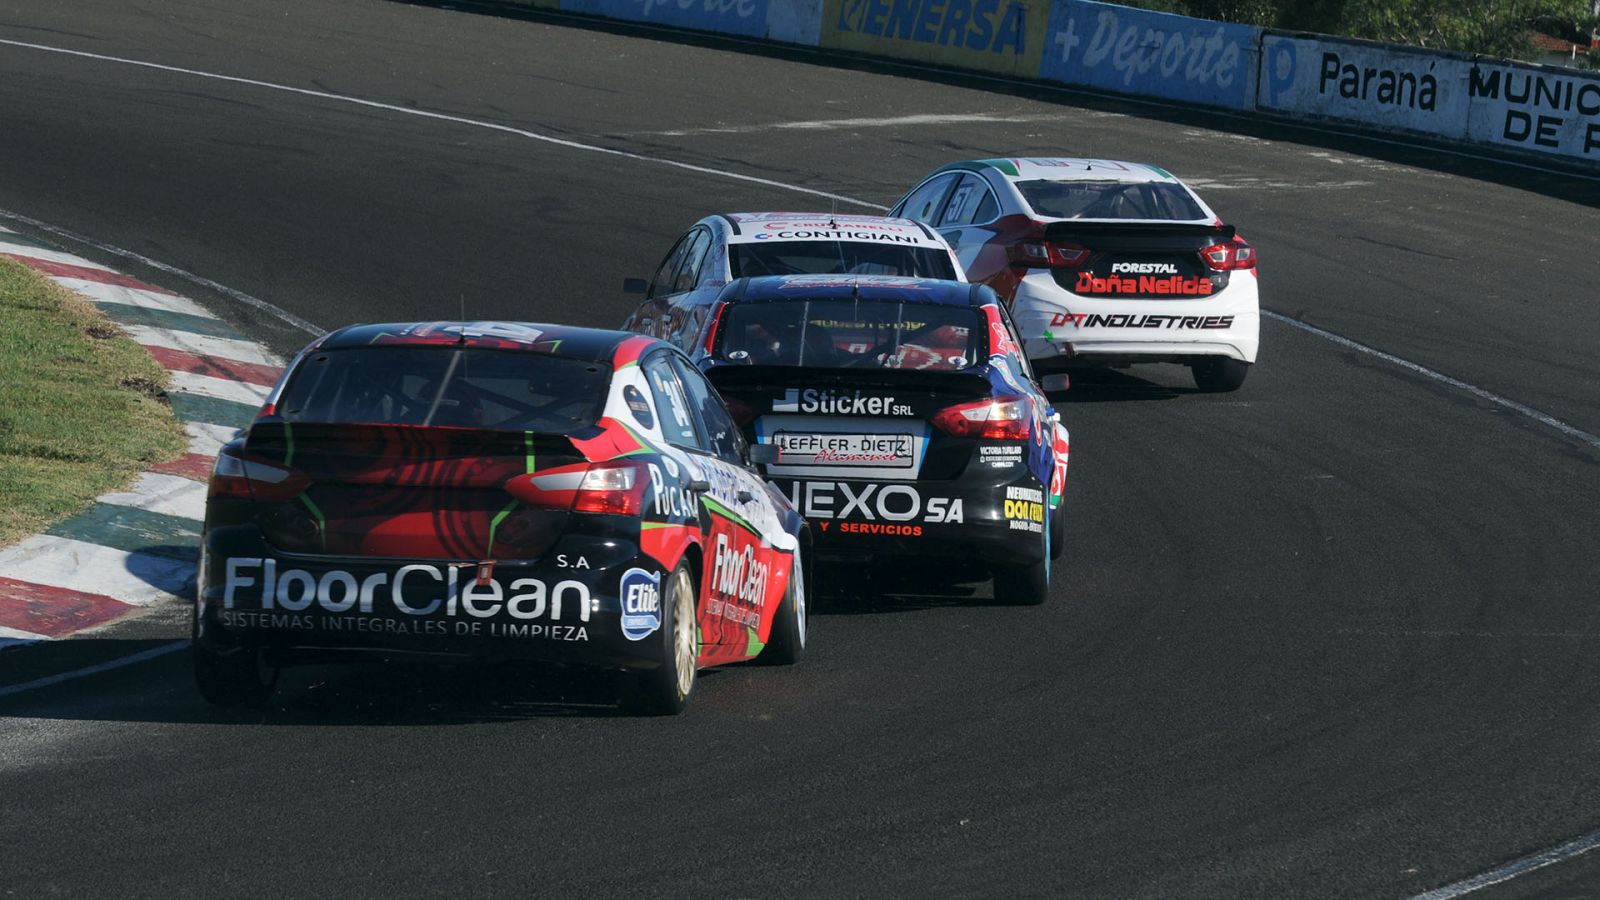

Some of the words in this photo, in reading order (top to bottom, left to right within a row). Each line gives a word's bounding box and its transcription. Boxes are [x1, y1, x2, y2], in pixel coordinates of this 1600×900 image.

[1082, 10, 1240, 89] Deporte
[1319, 52, 1437, 112] Paraná
[1503, 109, 1563, 148] DE
[778, 230, 918, 244] CONTIGIANI
[1112, 262, 1178, 274] FORESTAL
[1075, 271, 1138, 294] Doña
[1139, 274, 1213, 295] Nelida
[801, 388, 894, 415] Sticker
[893, 405, 914, 416] SRL
[781, 437, 849, 452] LEFFLER
[861, 439, 907, 453] DIETZ
[924, 497, 963, 523] SA
[819, 521, 830, 532] Y
[840, 522, 922, 536] SERVICIOS
[556, 554, 590, 569] S.A
[712, 532, 767, 608] FloorClean
[223, 557, 591, 622] FloorClean
[627, 583, 657, 613] Elite
[223, 611, 314, 630] SISTEMAS
[456, 621, 481, 636] DE
[491, 622, 589, 641] LIMPIEZA
